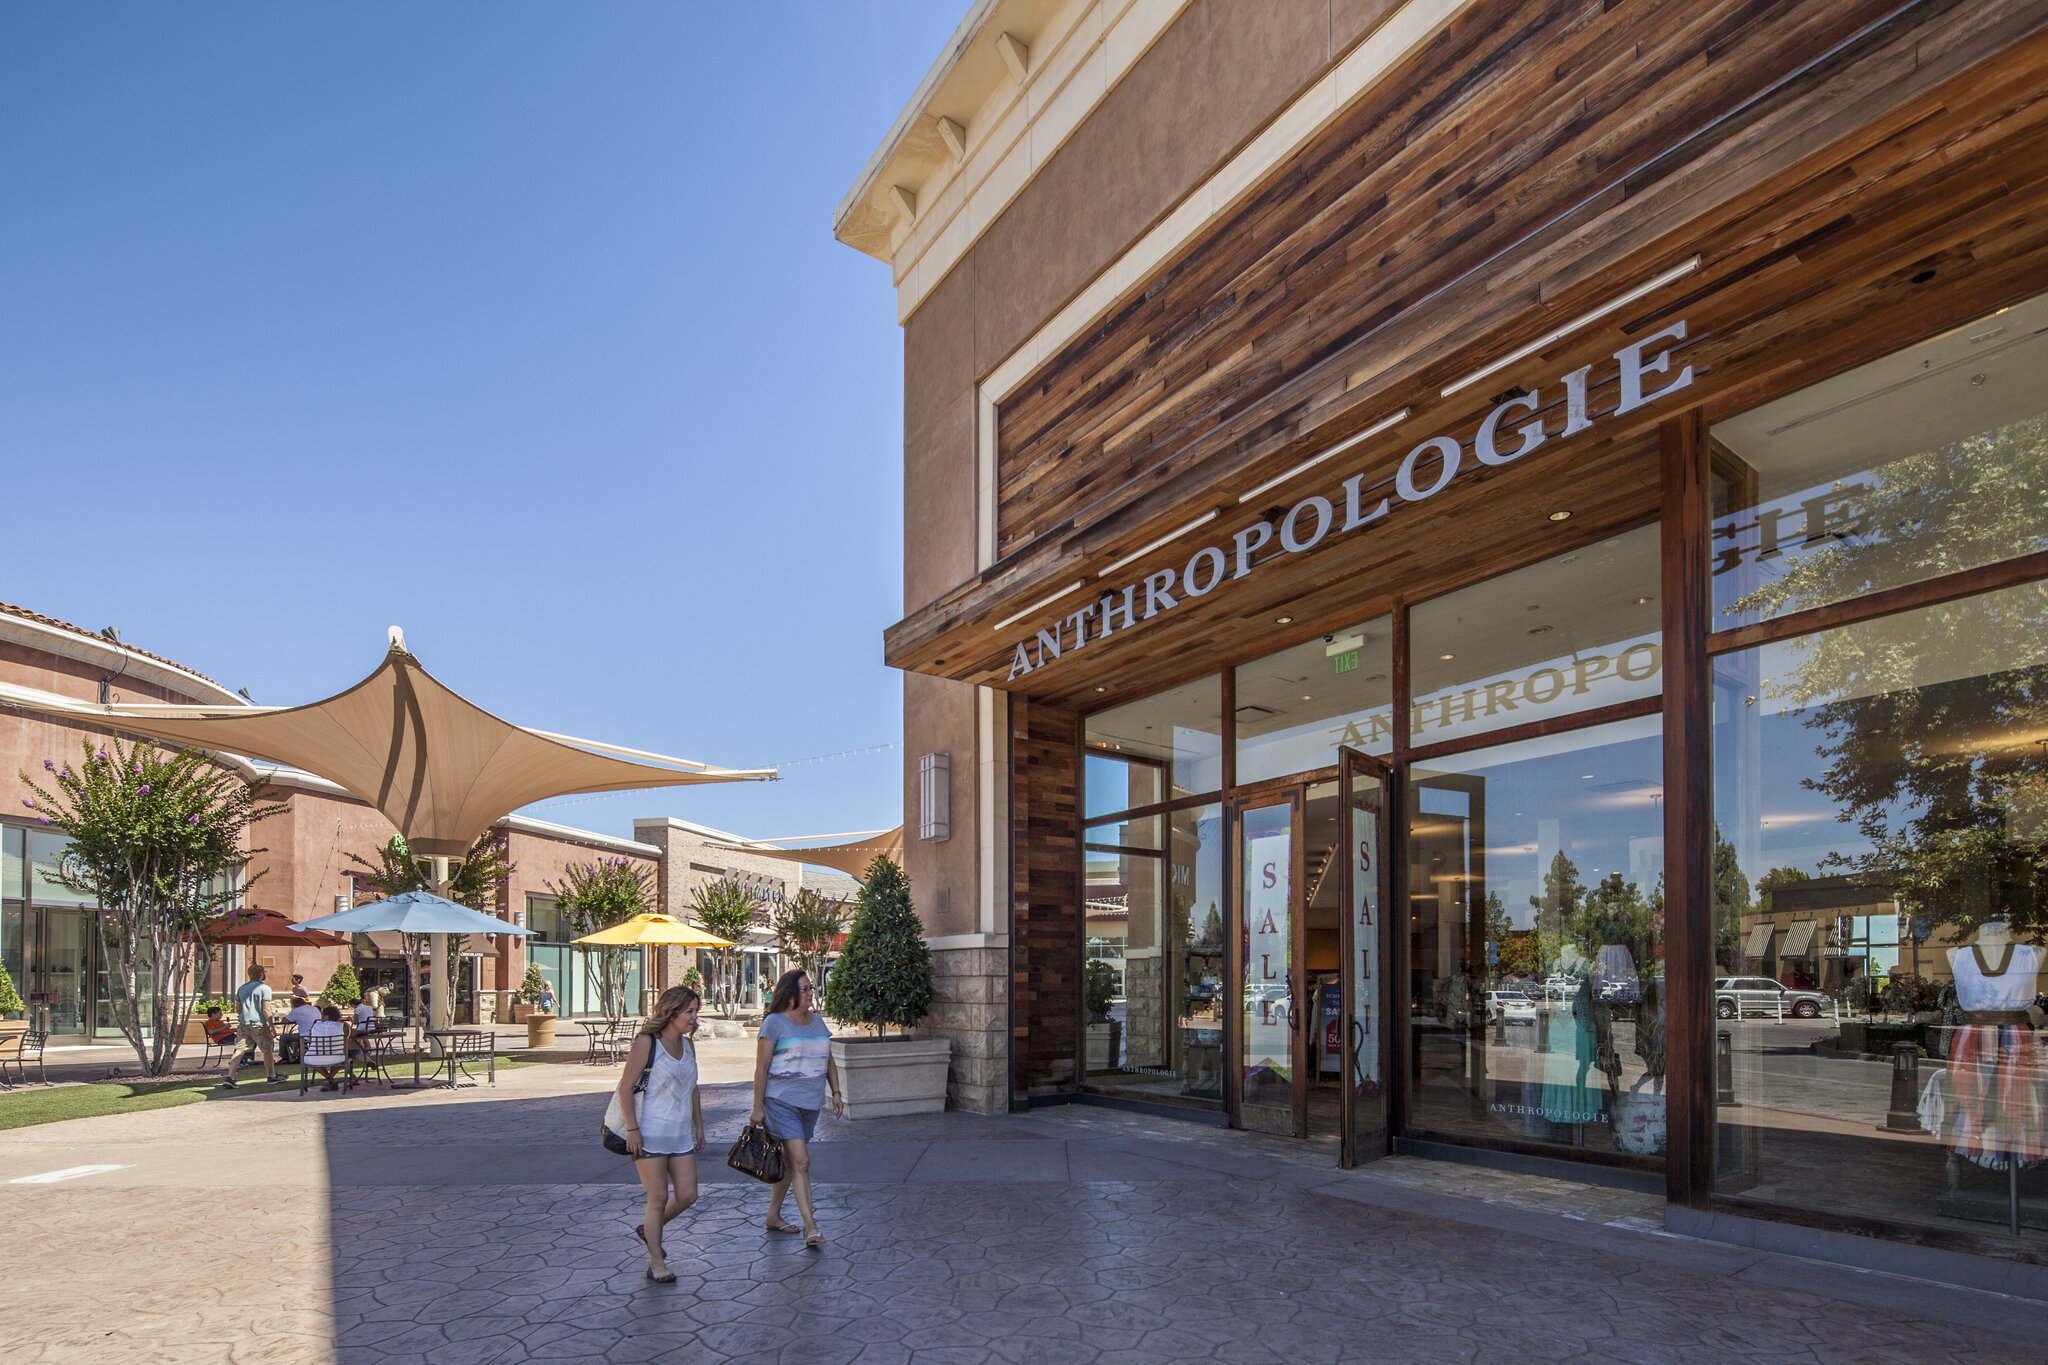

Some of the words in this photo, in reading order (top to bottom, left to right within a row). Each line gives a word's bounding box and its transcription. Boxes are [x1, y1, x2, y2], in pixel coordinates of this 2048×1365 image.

[1007, 319, 1694, 682] ANTHROPOLOGIE
[1258, 861, 1279, 1026] SALE
[1326, 1007, 1341, 1016] SA
[1489, 1103, 1609, 1123] ANTHROPOLOGIE
